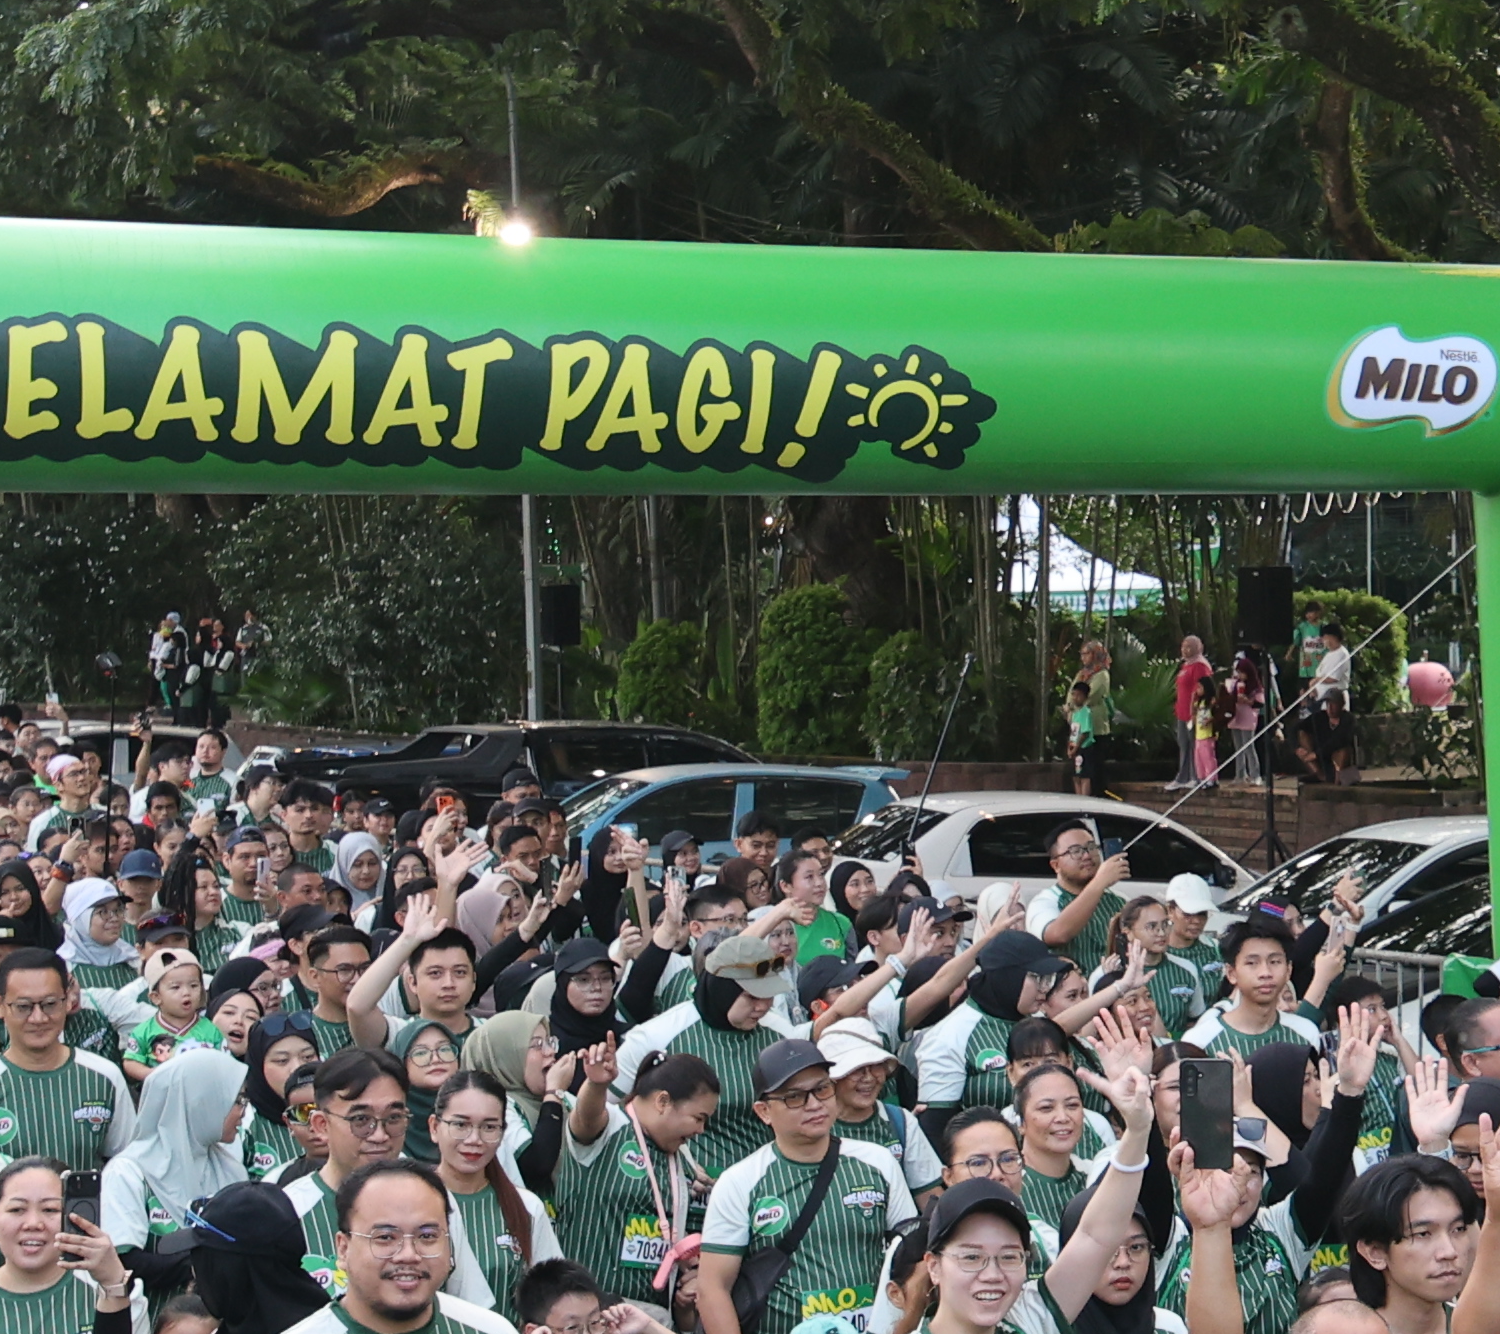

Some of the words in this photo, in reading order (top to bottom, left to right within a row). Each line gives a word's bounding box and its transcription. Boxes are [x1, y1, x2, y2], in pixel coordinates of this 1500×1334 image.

[1440, 349, 1479, 363] Nestlé
[1354, 356, 1479, 406] MILO
[541, 340, 843, 469] PAGI!
[755, 1210, 781, 1224] MILO
[801, 1288, 857, 1318] MILO
